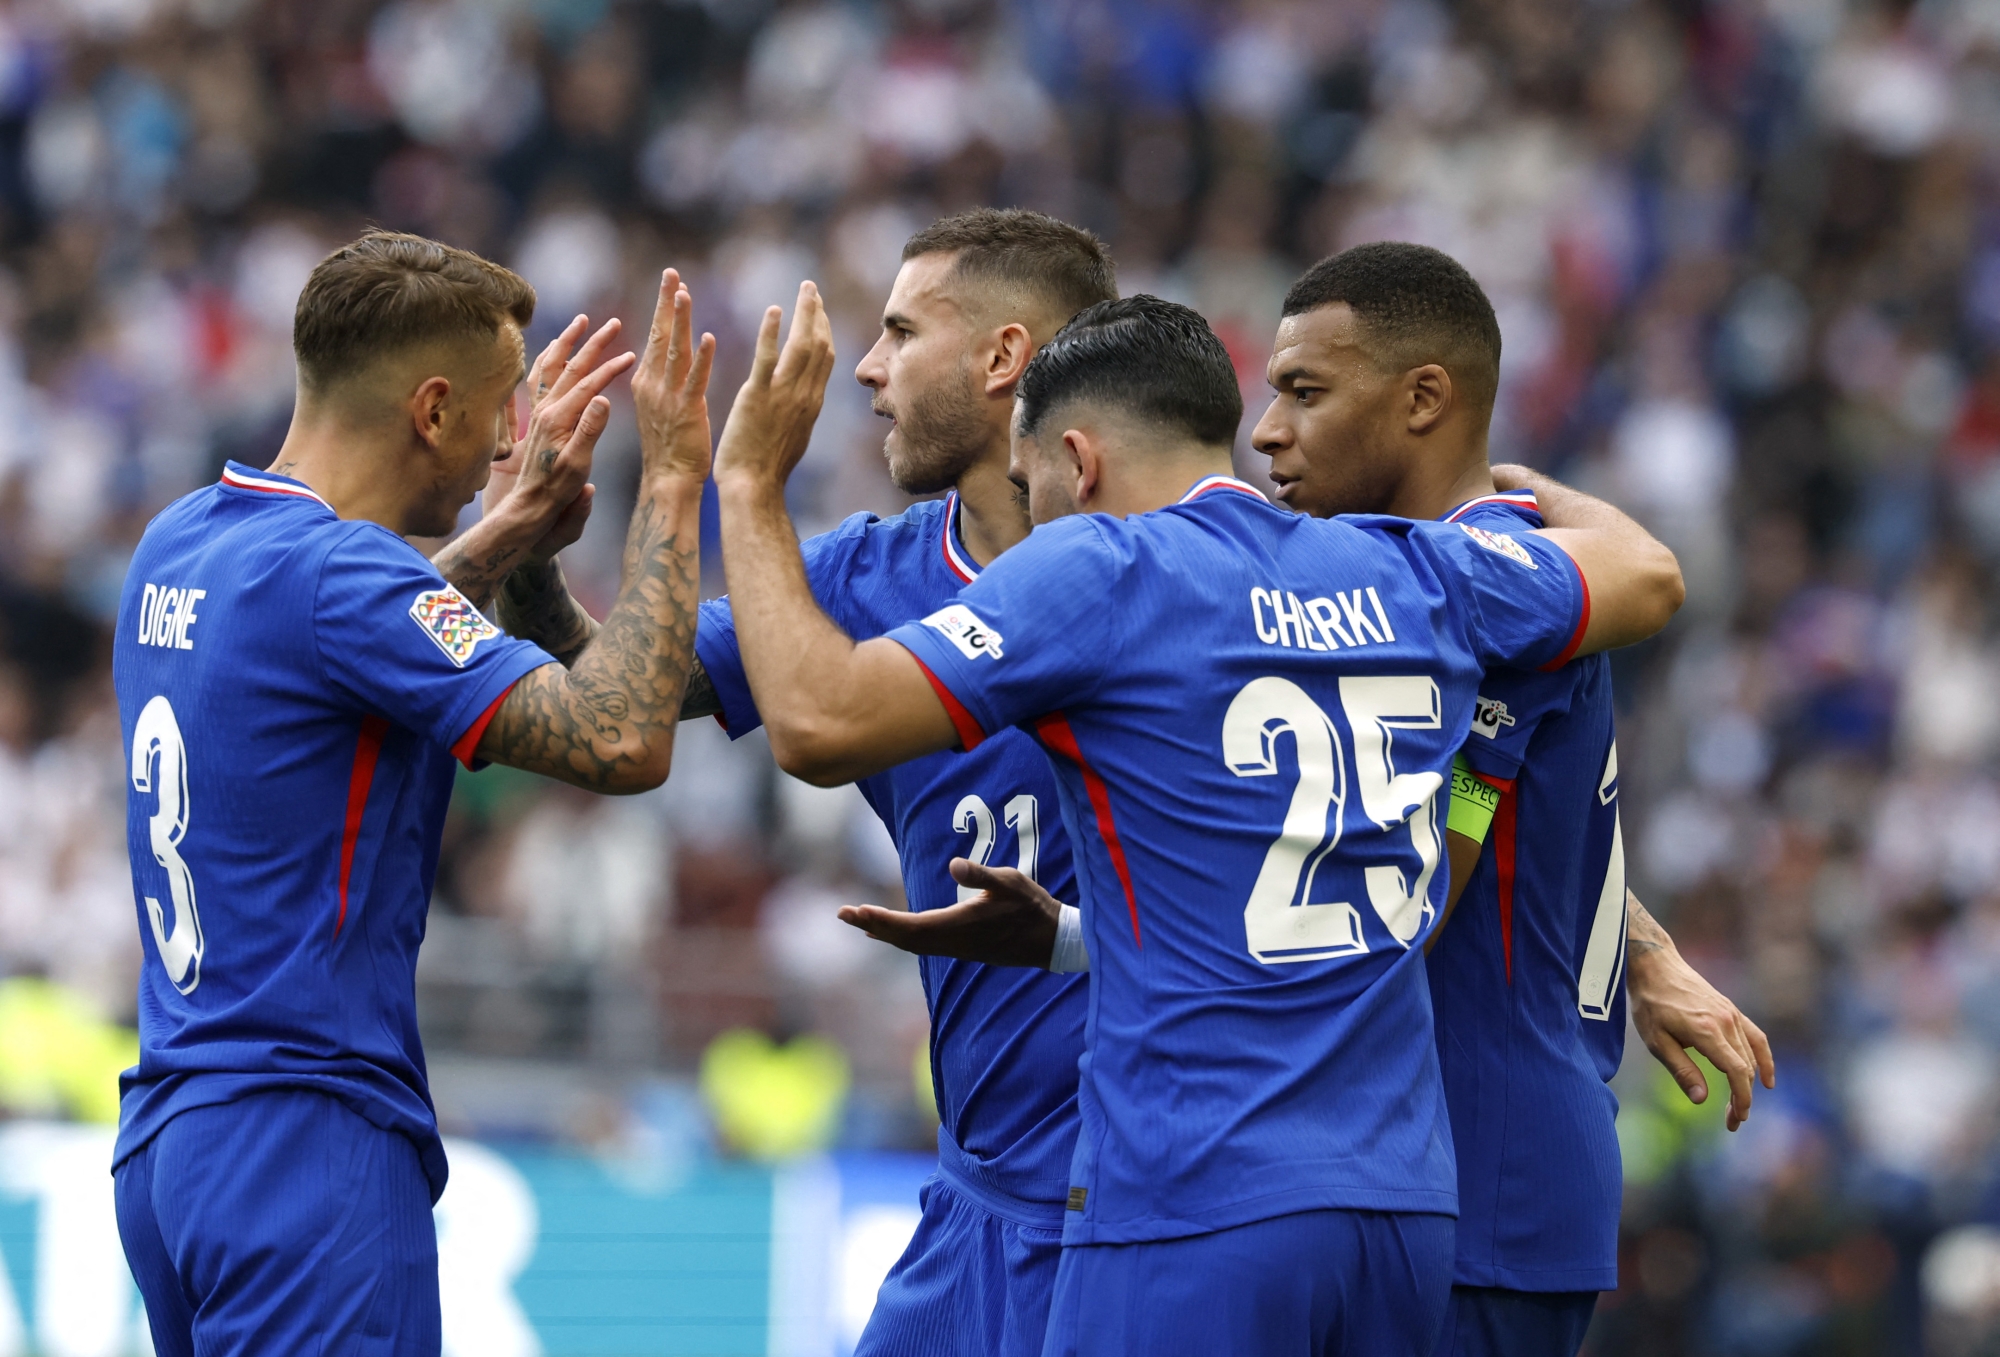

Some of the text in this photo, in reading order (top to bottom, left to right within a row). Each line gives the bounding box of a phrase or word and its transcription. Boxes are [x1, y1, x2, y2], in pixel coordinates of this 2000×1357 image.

[138, 583, 207, 650] DIGNE
[962, 625, 987, 649] 10
[1250, 586, 1396, 651] CHERKI
[132, 695, 205, 995] 3
[953, 794, 1040, 904] 21
[1222, 676, 1443, 965] 25
